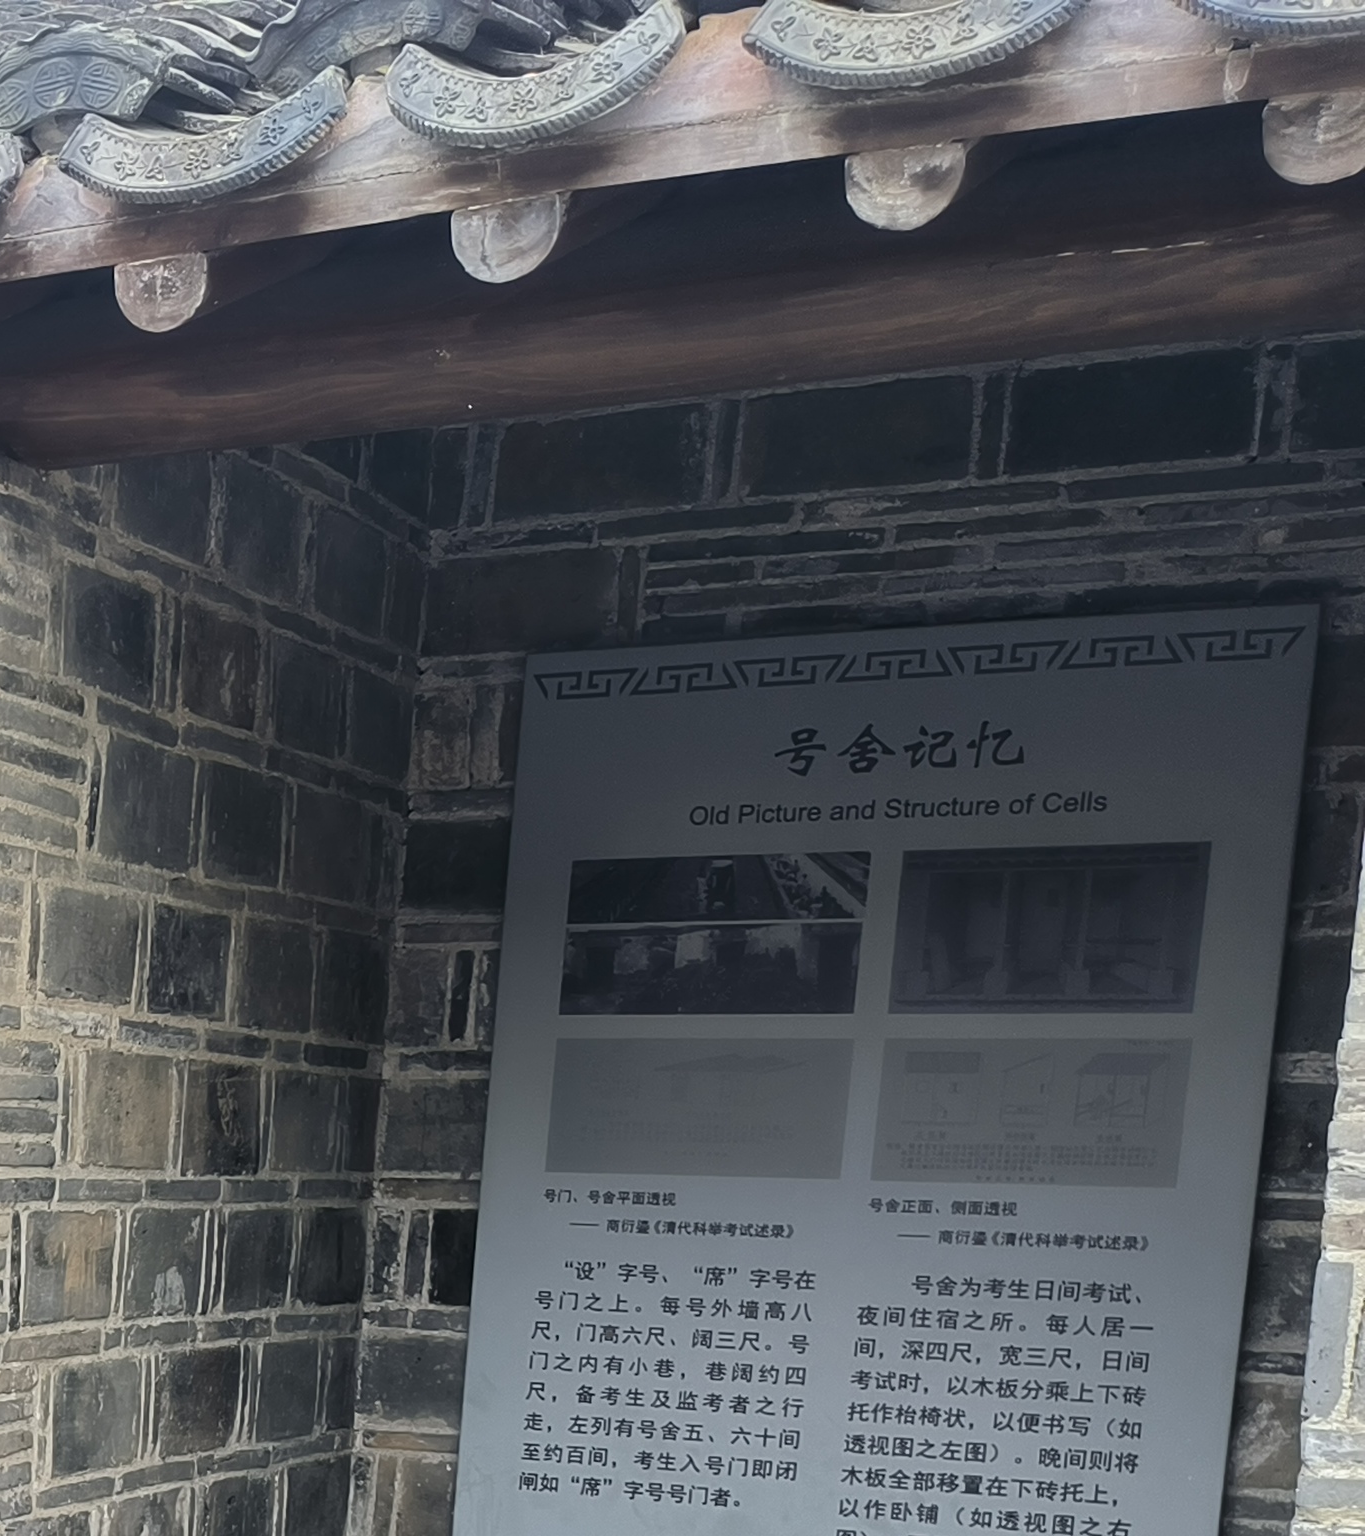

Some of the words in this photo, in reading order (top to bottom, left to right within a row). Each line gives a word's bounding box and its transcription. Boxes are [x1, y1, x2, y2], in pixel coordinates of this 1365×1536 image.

[774, 720, 1026, 777] 号舍记忆
[689, 805, 730, 826] Old
[737, 803, 822, 824] Picture
[829, 799, 876, 821] and
[884, 798, 1000, 820] Structure
[1009, 793, 1038, 815] of
[1042, 791, 1108, 814] Cells
[543, 1188, 677, 1206] 号门、号舍平面透视
[868, 1197, 1018, 1217] 号舍正面、侧面透视
[911, 1274, 1142, 1305] 号舍为考生日间考试、
[534, 1291, 813, 1323] 号门之上。每号外墙高八
[856, 1305, 1155, 1338] 夜间住宿之所。每人居一
